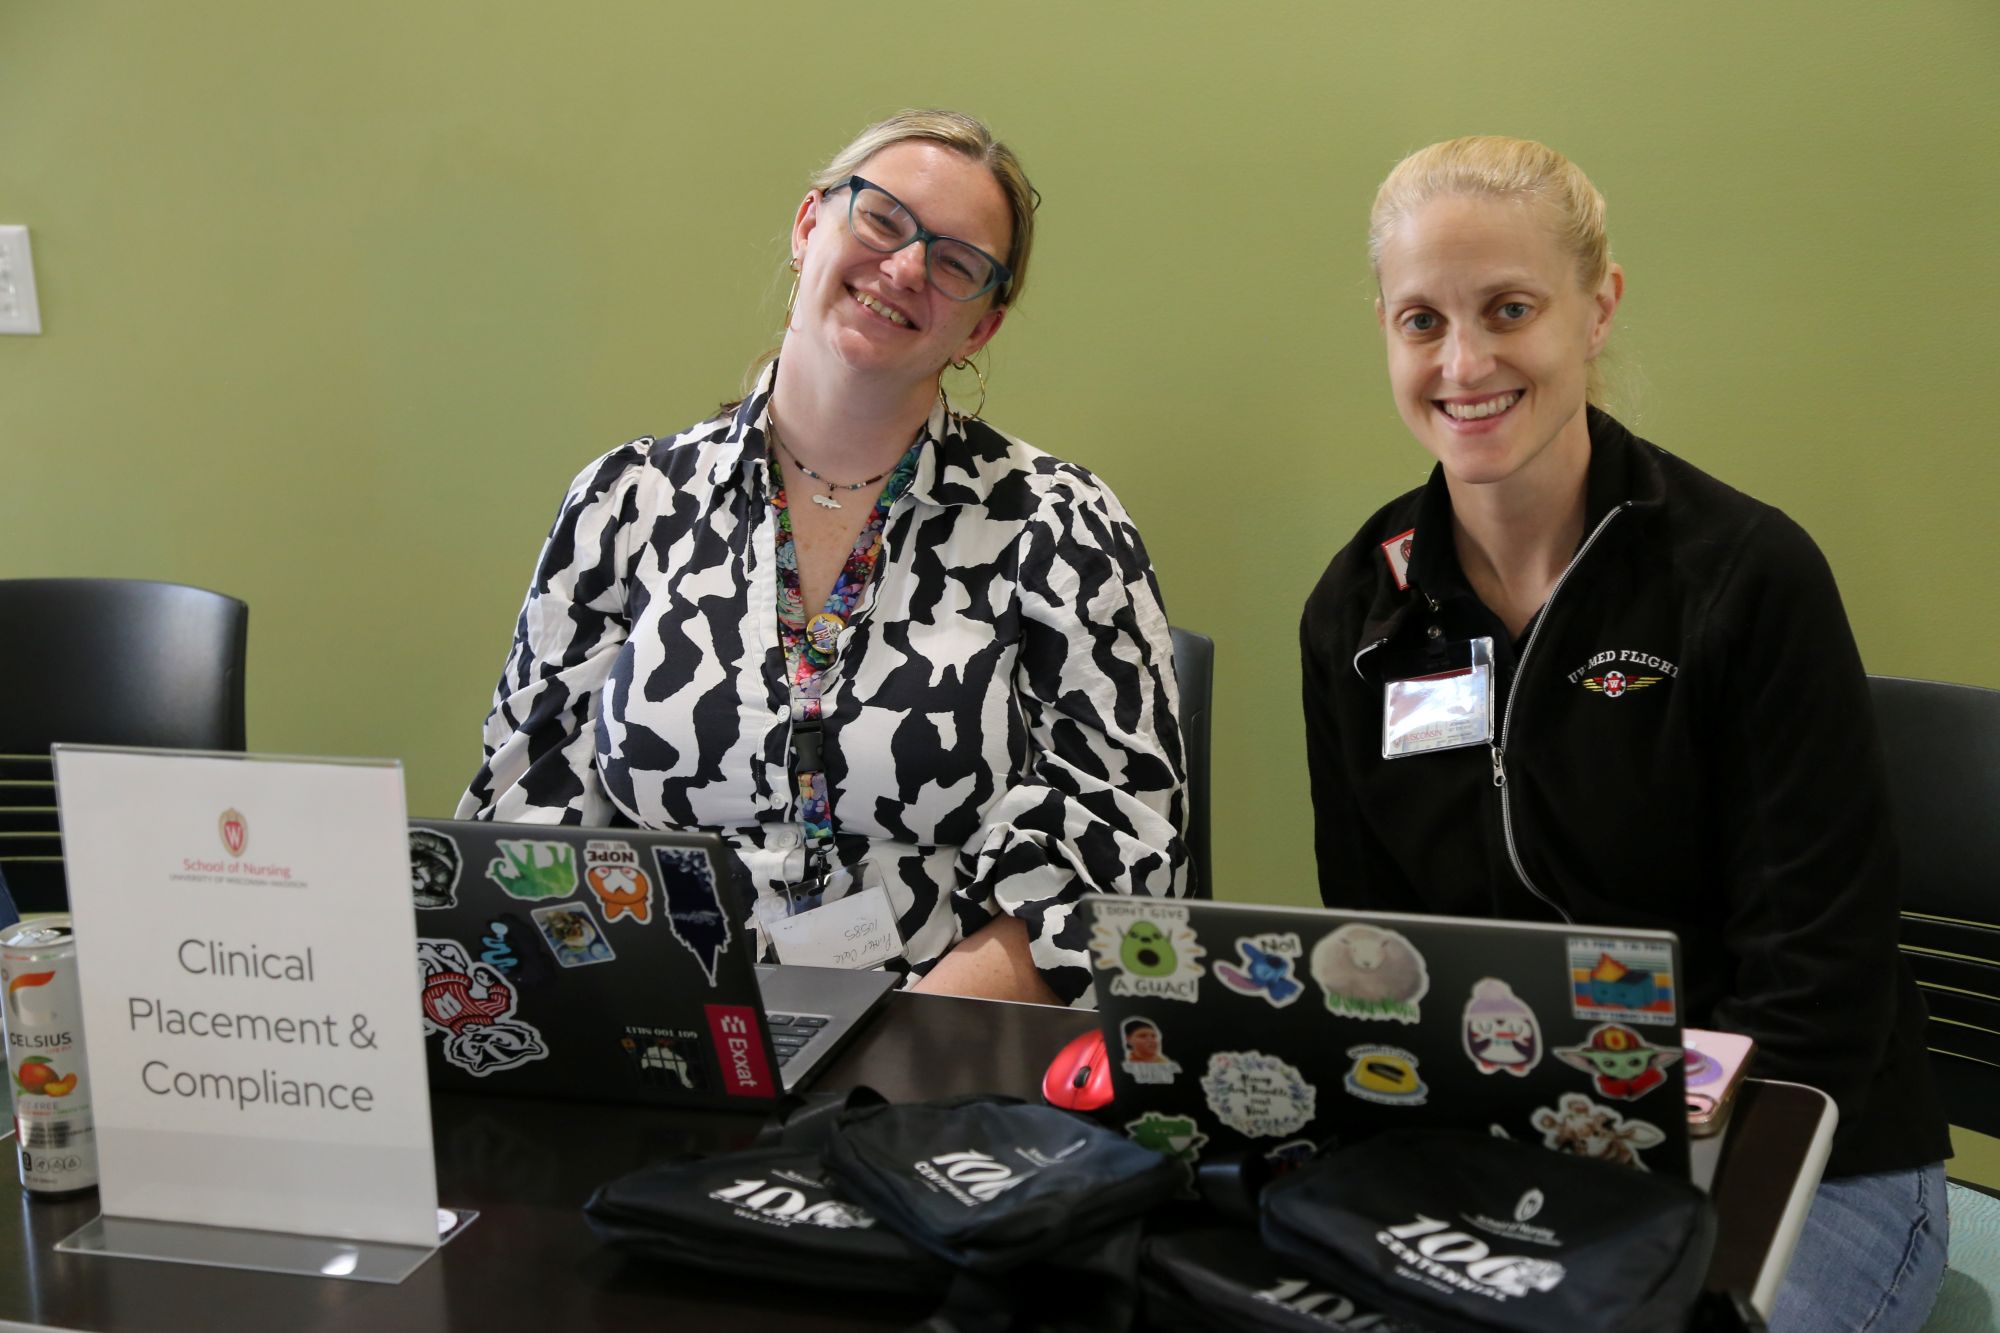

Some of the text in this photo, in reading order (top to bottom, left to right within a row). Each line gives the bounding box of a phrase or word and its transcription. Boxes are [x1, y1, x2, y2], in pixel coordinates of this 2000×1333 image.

[1587, 650, 1616, 670] MED
[587, 851, 635, 864] NOPE
[183, 858, 292, 879] School of Nursing
[1150, 908, 1183, 920] GIVE
[178, 939, 314, 982] Clinical
[1114, 979, 1195, 997] A GUAC!
[129, 997, 379, 1050] Placement &
[653, 1028, 675, 1038] TOO
[10, 1032, 72, 1049] CELSIUS
[728, 1037, 758, 1087] Exxat
[142, 1061, 375, 1113] Compliance
